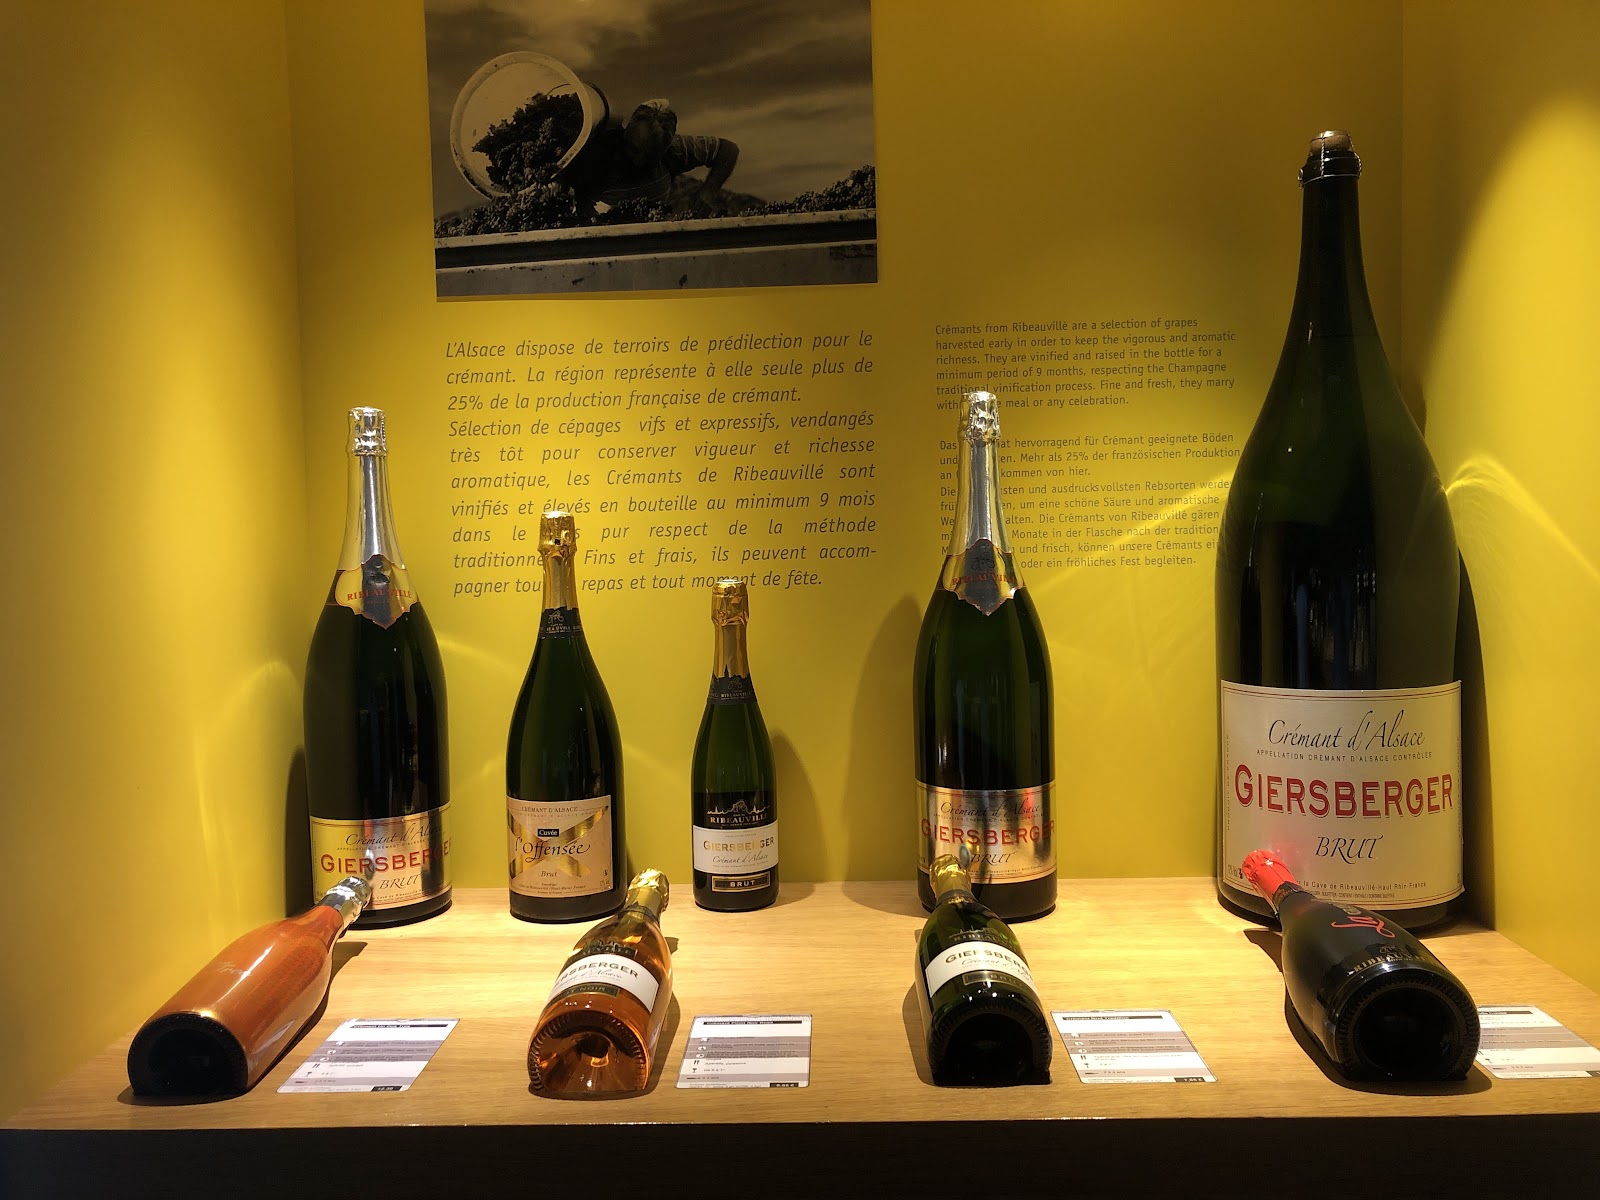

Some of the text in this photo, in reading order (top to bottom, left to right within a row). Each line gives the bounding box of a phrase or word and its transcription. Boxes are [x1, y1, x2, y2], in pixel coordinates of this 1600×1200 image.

[935, 318, 1198, 335] Crémants from Ribeauvillé selection grapes
[446, 332, 850, 360] L'Alsace dispose terroirs prédilection pour
[936, 330, 1236, 350] harvested early order keep vigorous aromatic
[936, 347, 1195, 366] richness. They vinified raised bottle
[446, 358, 845, 386] crémant. région représente elle seule plus
[936, 362, 1226, 381] minimum period months, respecting Champagne
[937, 378, 1234, 395] traditional vinification process. Fine fresh, they marry
[448, 387, 801, 412] 25% production française crémant.
[937, 394, 1129, 410] with meal celebration.
[448, 410, 874, 438] Sélection cépages vifs expressifs, vendangés
[1014, 432, 1234, 449] hervorragend Crémant geeignete Böden
[450, 437, 875, 464] très tôt pour conserver vigueur richesse
[1020, 447, 1240, 463] Mehr 25% französischen Produktion
[451, 464, 876, 491] aromatique, les Crémants Ribeauvillé sont
[1001, 466, 1090, 477] kommen hier.
[1051, 482, 1141, 494] ausdrucksvollsten
[1145, 480, 1196, 491] Rebsorten
[452, 499, 509, 520] vinifiés
[628, 495, 698, 512] bouteille
[735, 492, 810, 509] minimum
[838, 490, 876, 506] mois
[1038, 494, 1220, 509] eine schöne Säure aromatische
[1058, 509, 1220, 523] Crémants Ribeauvillé gären
[452, 516, 876, 542] dans pur respect méthode
[1012, 526, 1150, 539] Monate Flasche nach
[584, 545, 877, 567] Fins frais, ils peuvent accom-
[1042, 540, 1203, 554] frisch, können unsere Crémants
[1066, 556, 1116, 568] fröhliches
[1120, 556, 1141, 566] Fest
[1144, 554, 1196, 568] begleiten.
[453, 569, 822, 598] pagner repas tout fête.
[1268, 709, 1426, 751] Crémant d'Alsace
[1256, 749, 1432, 762] APPELLATION CRÉMANT D'ALSACE CONTRÔLÉE
[1234, 763, 1454, 819] GIERSBERGER
[921, 818, 1055, 846] GIERSBERGER
[515, 836, 591, 863] l'Offensée
[703, 836, 774, 851] GIERSBERGER
[1315, 835, 1384, 864] BRUT
[320, 838, 451, 875] GIERSBERGE
[970, 851, 1016, 866] BRUT
[379, 873, 422, 890] BRUT
[541, 870, 558, 878] Brut
[729, 879, 756, 888] BRUT
